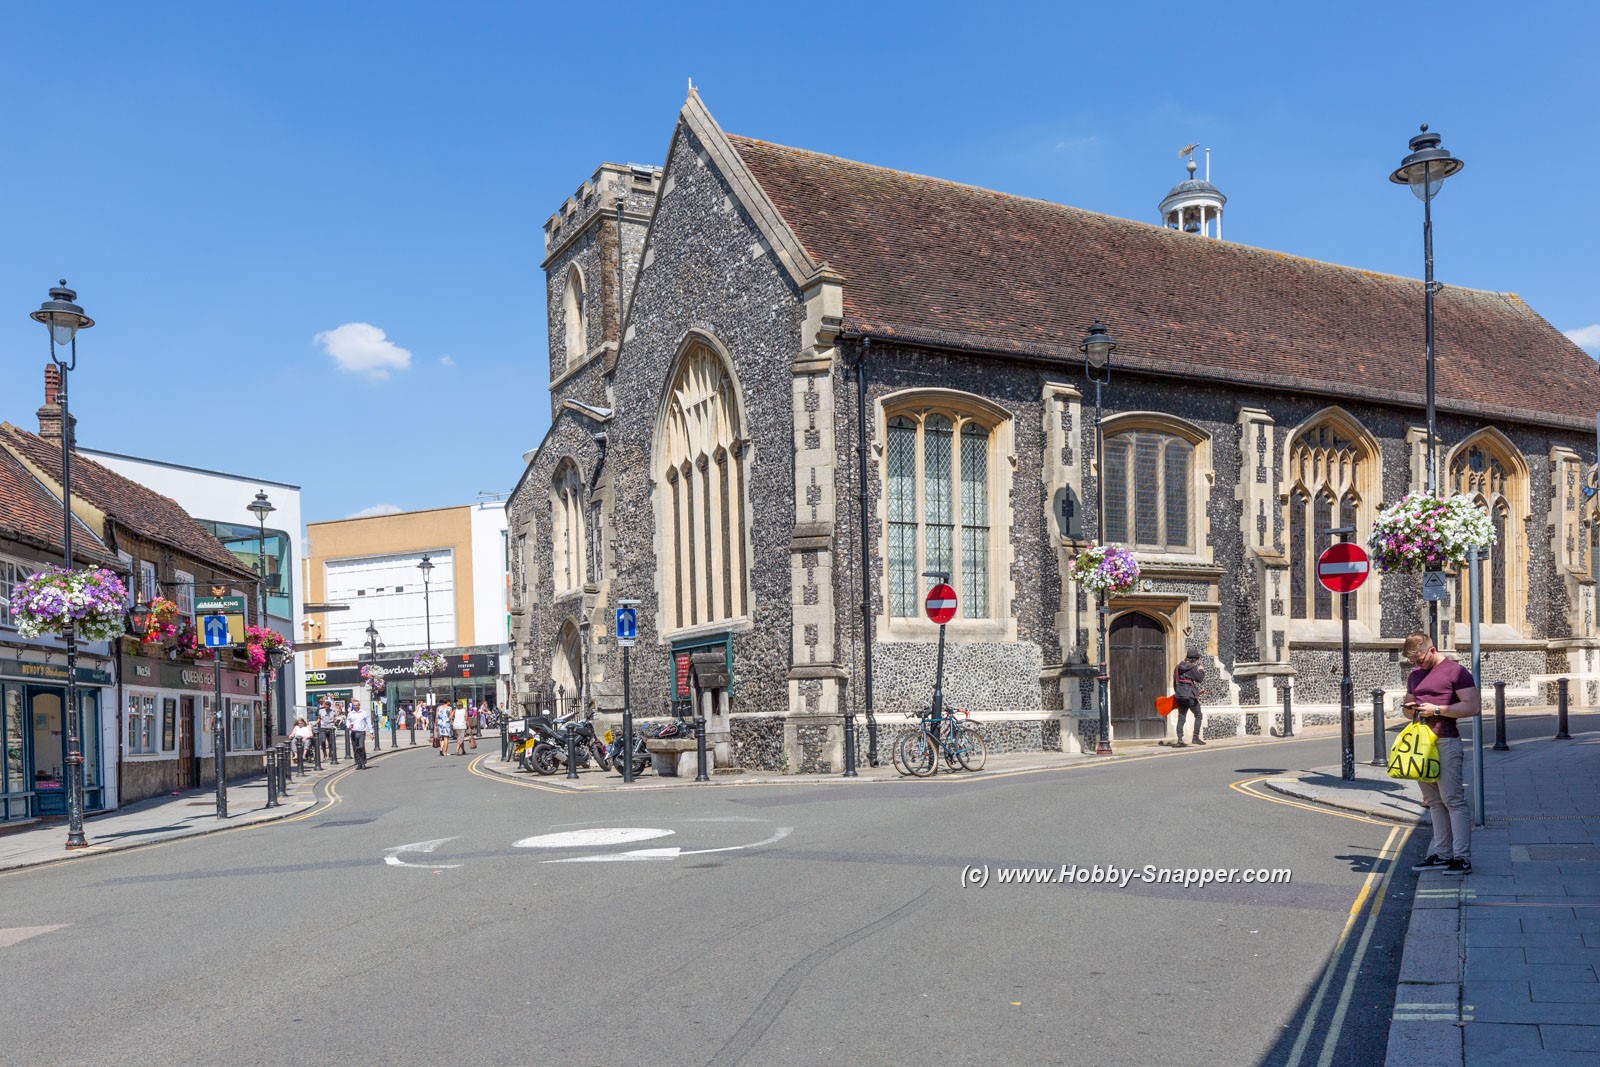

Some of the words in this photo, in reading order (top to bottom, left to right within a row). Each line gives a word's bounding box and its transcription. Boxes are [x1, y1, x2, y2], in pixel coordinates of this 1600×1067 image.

[181, 669, 204, 685] QUEENS
[1391, 732, 1424, 756] SL
[1387, 754, 1441, 779] AND
